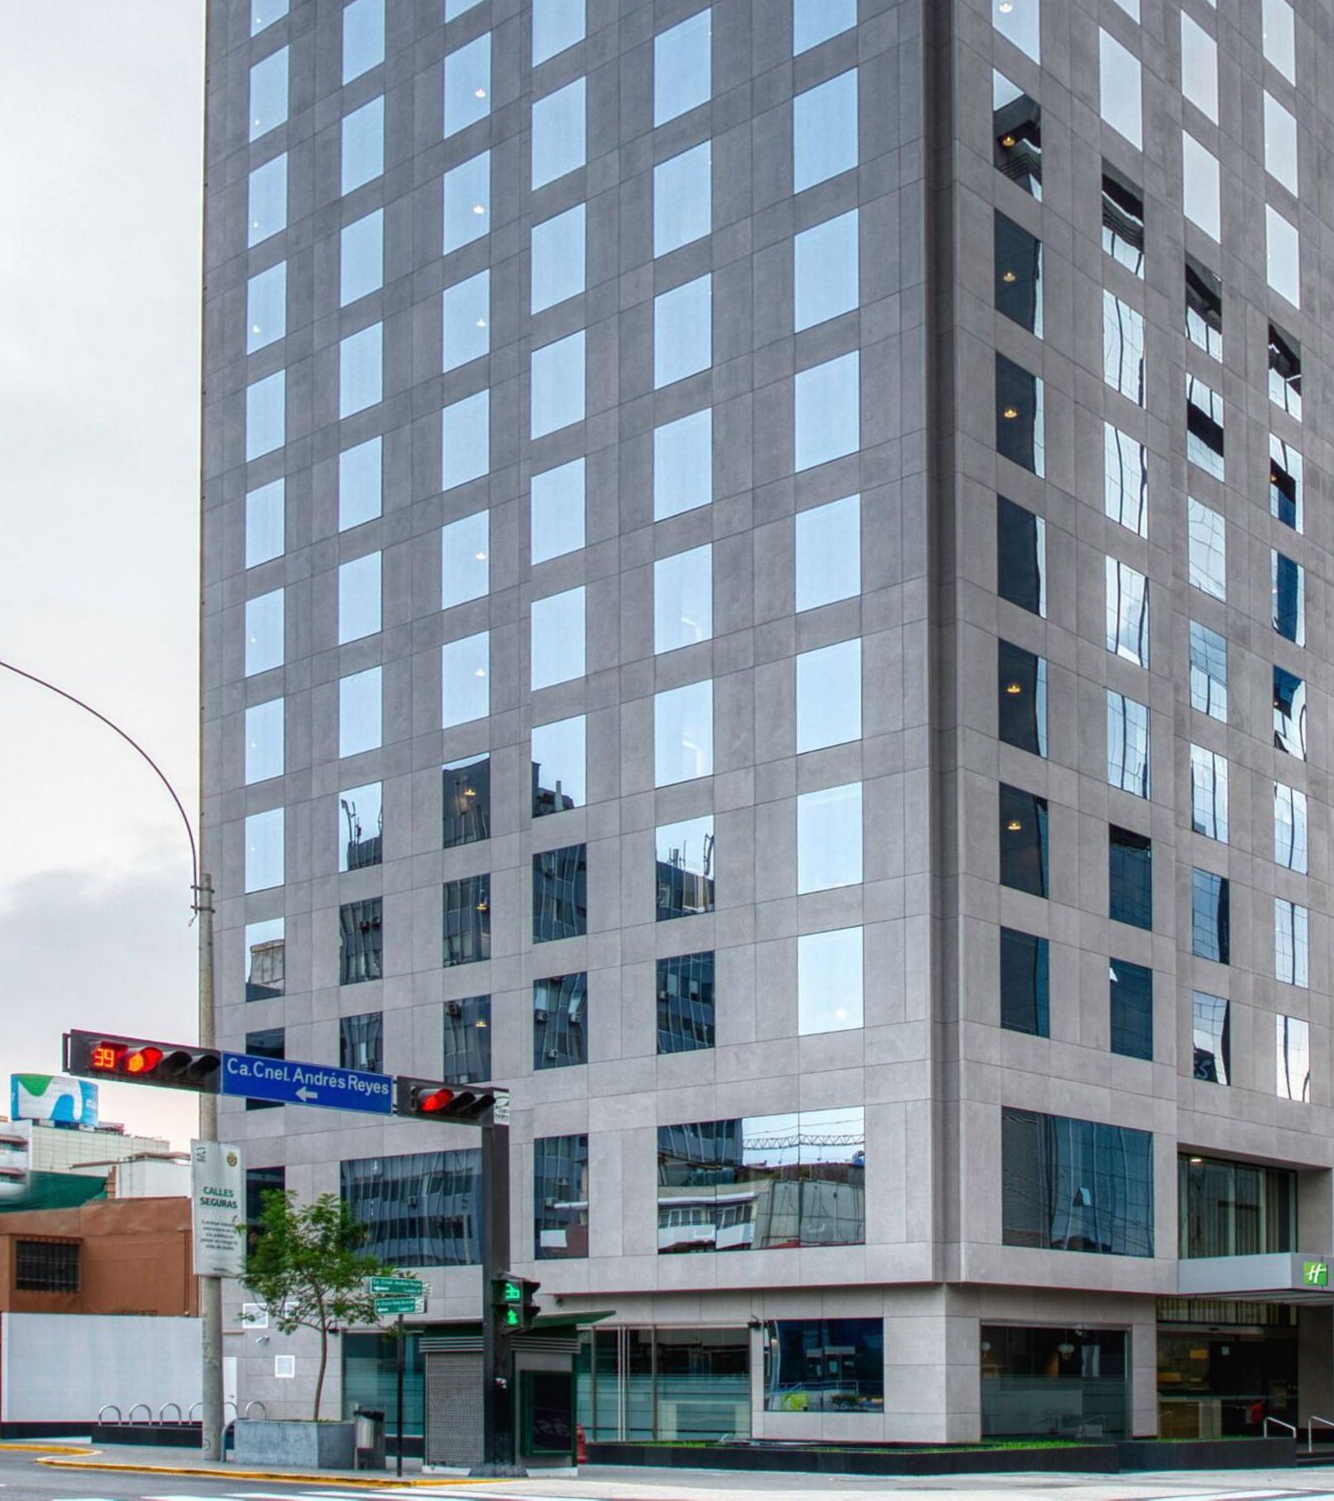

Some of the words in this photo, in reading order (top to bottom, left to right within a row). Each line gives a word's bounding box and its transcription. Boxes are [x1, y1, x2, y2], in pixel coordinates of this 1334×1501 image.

[94, 1047, 115, 1068] 39
[227, 1058, 252, 1077] Ca.
[253, 1061, 290, 1082] Cnel.
[292, 1067, 346, 1089] Andrés
[348, 1074, 390, 1097] Reyes
[203, 1186, 234, 1198] CALLES
[199, 1196, 238, 1209] SEGURAS
